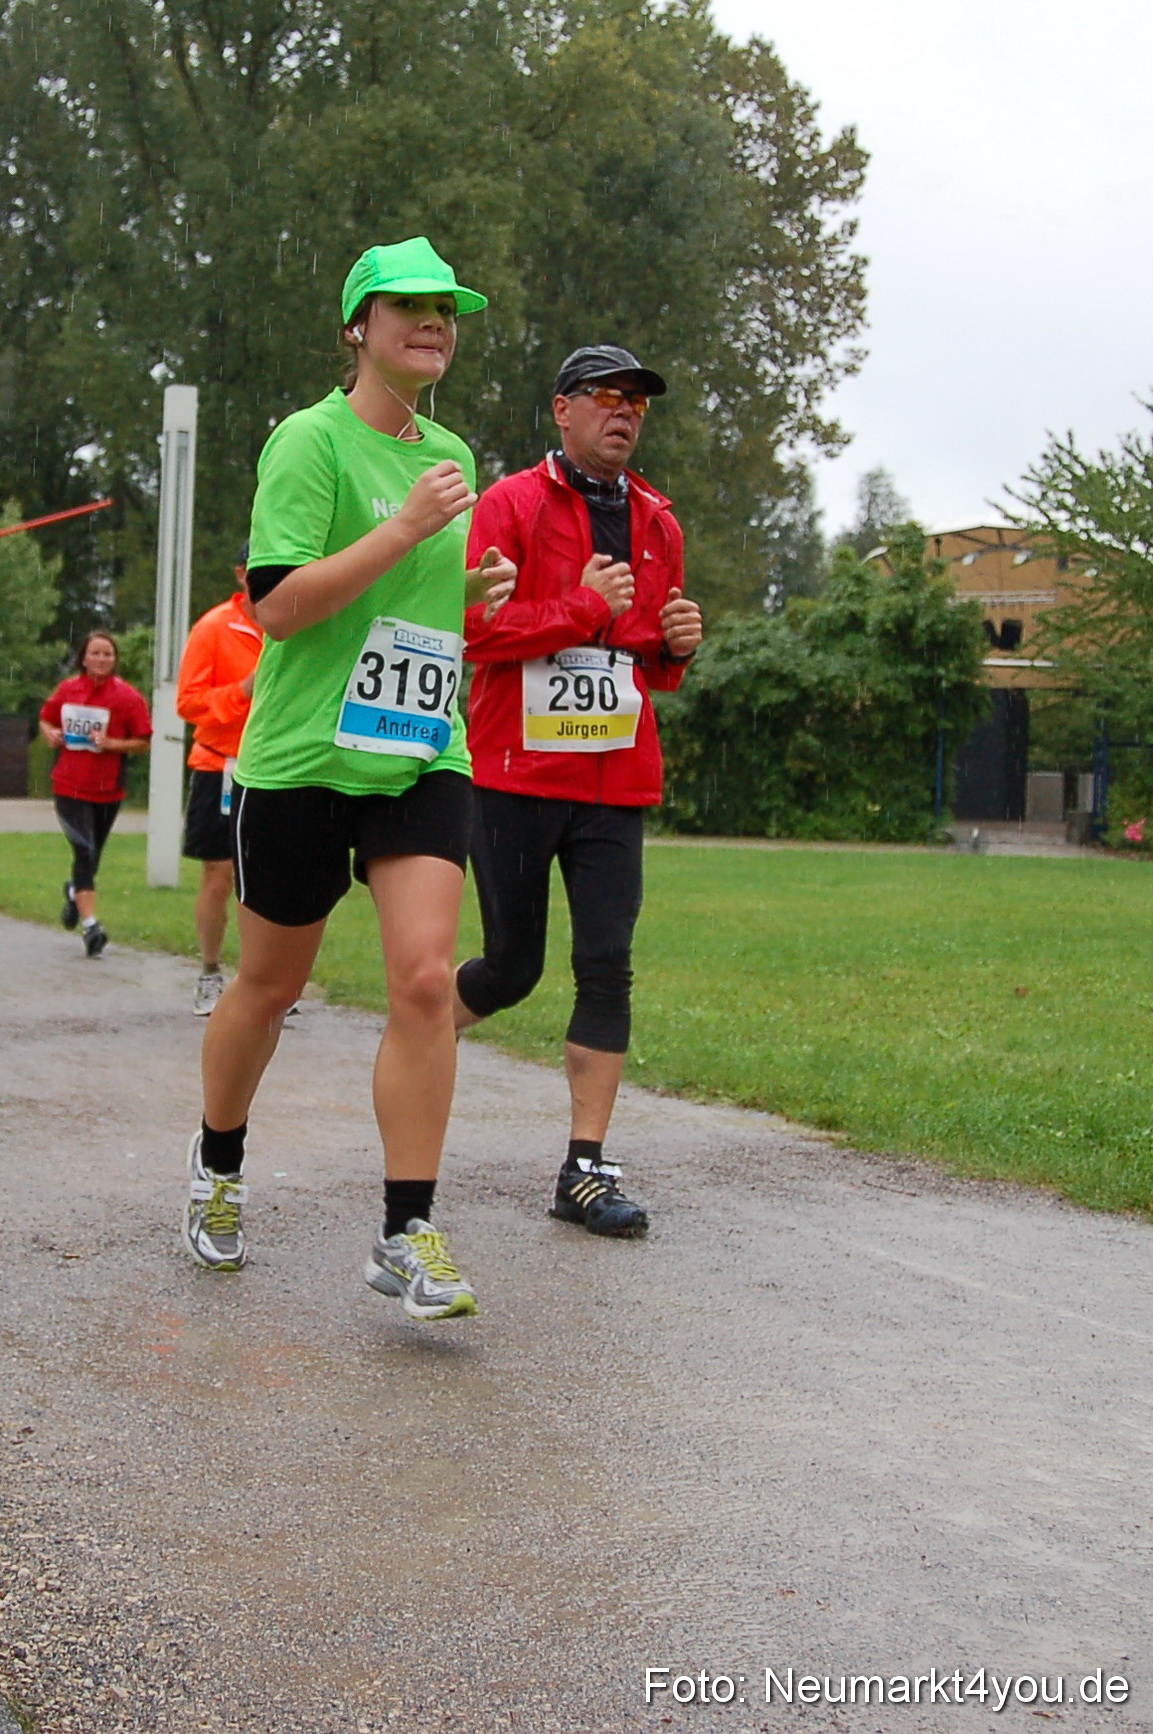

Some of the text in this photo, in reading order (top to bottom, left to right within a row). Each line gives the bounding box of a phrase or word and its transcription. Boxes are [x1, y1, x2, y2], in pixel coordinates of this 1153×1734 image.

[394, 629, 443, 650] BOCK
[357, 651, 457, 718] 3192
[549, 675, 619, 712] 290
[376, 716, 439, 742] Andrea
[557, 721, 609, 740] Jürgen
